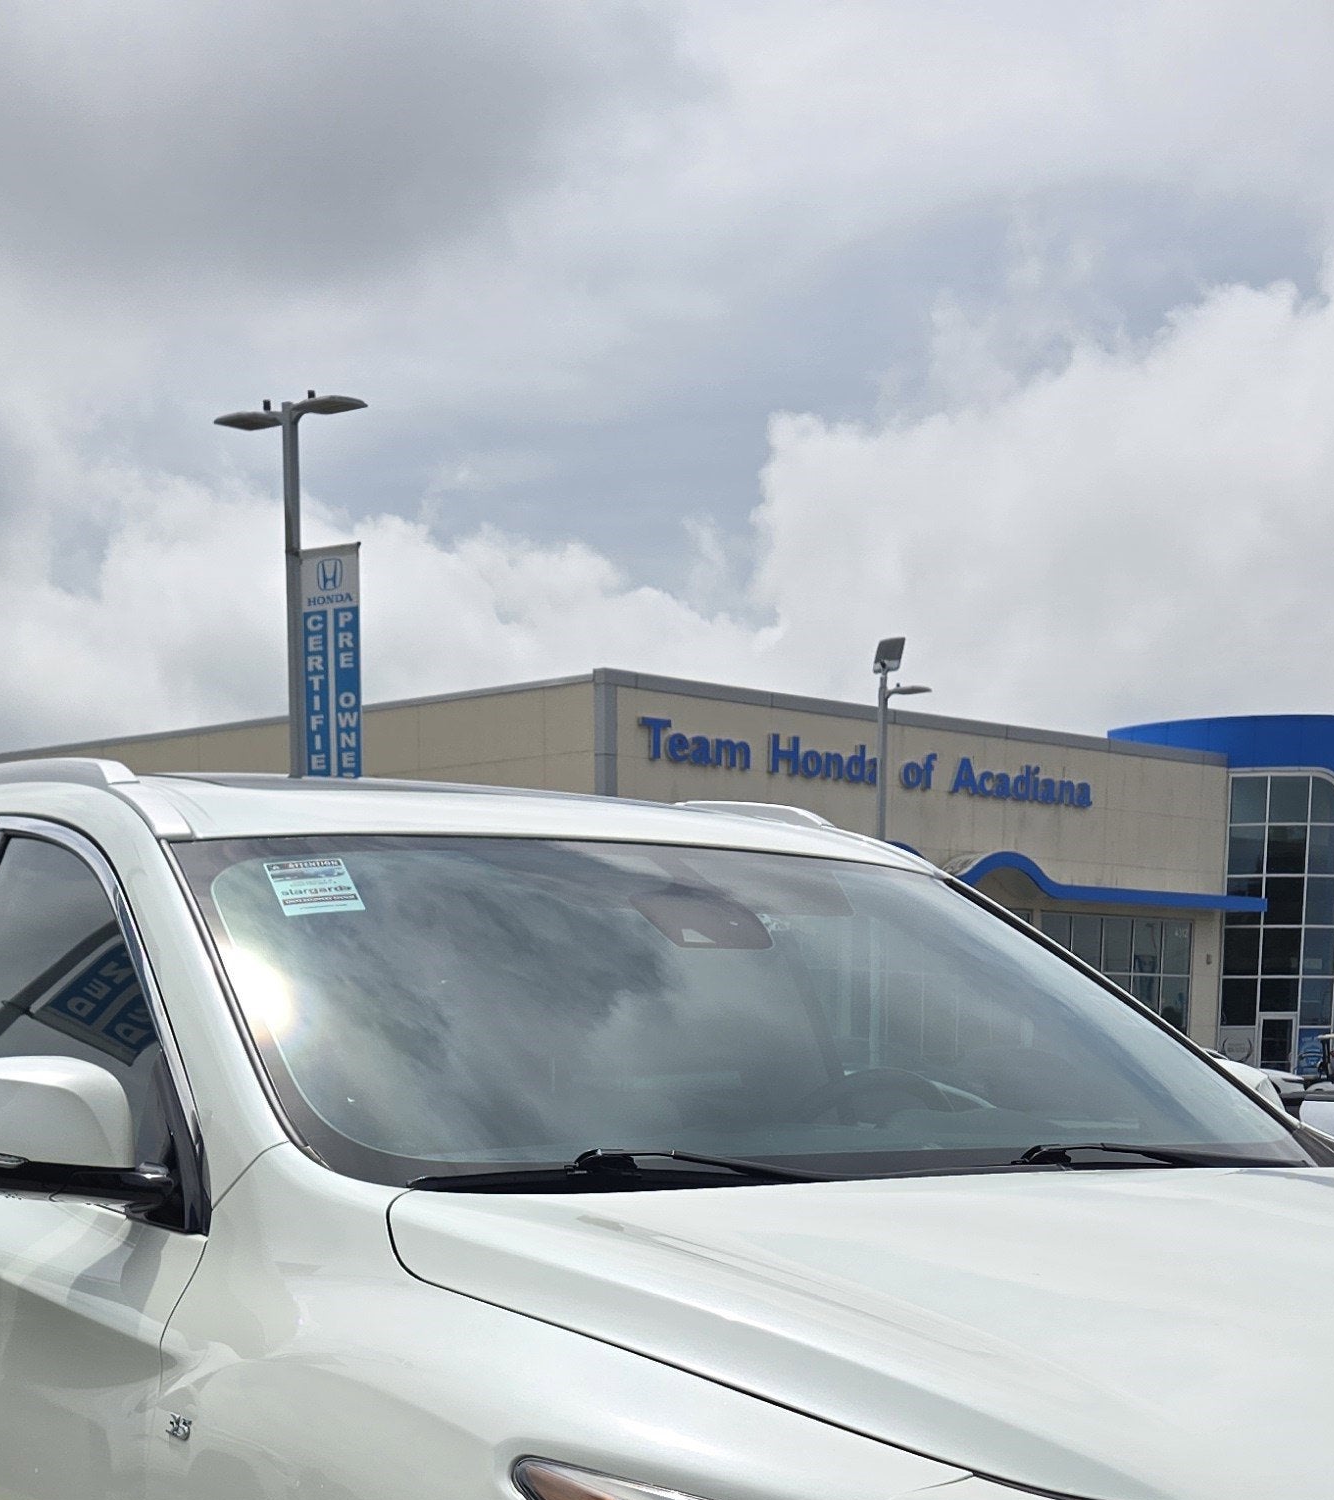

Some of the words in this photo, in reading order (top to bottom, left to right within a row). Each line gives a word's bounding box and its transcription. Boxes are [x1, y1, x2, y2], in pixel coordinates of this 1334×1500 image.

[307, 592, 353, 607] HONDA
[338, 612, 354, 669] PRE
[337, 691, 359, 778] OWNE
[638, 716, 751, 771] Team
[899, 752, 938, 791] of
[949, 756, 1093, 808] Acadiana
